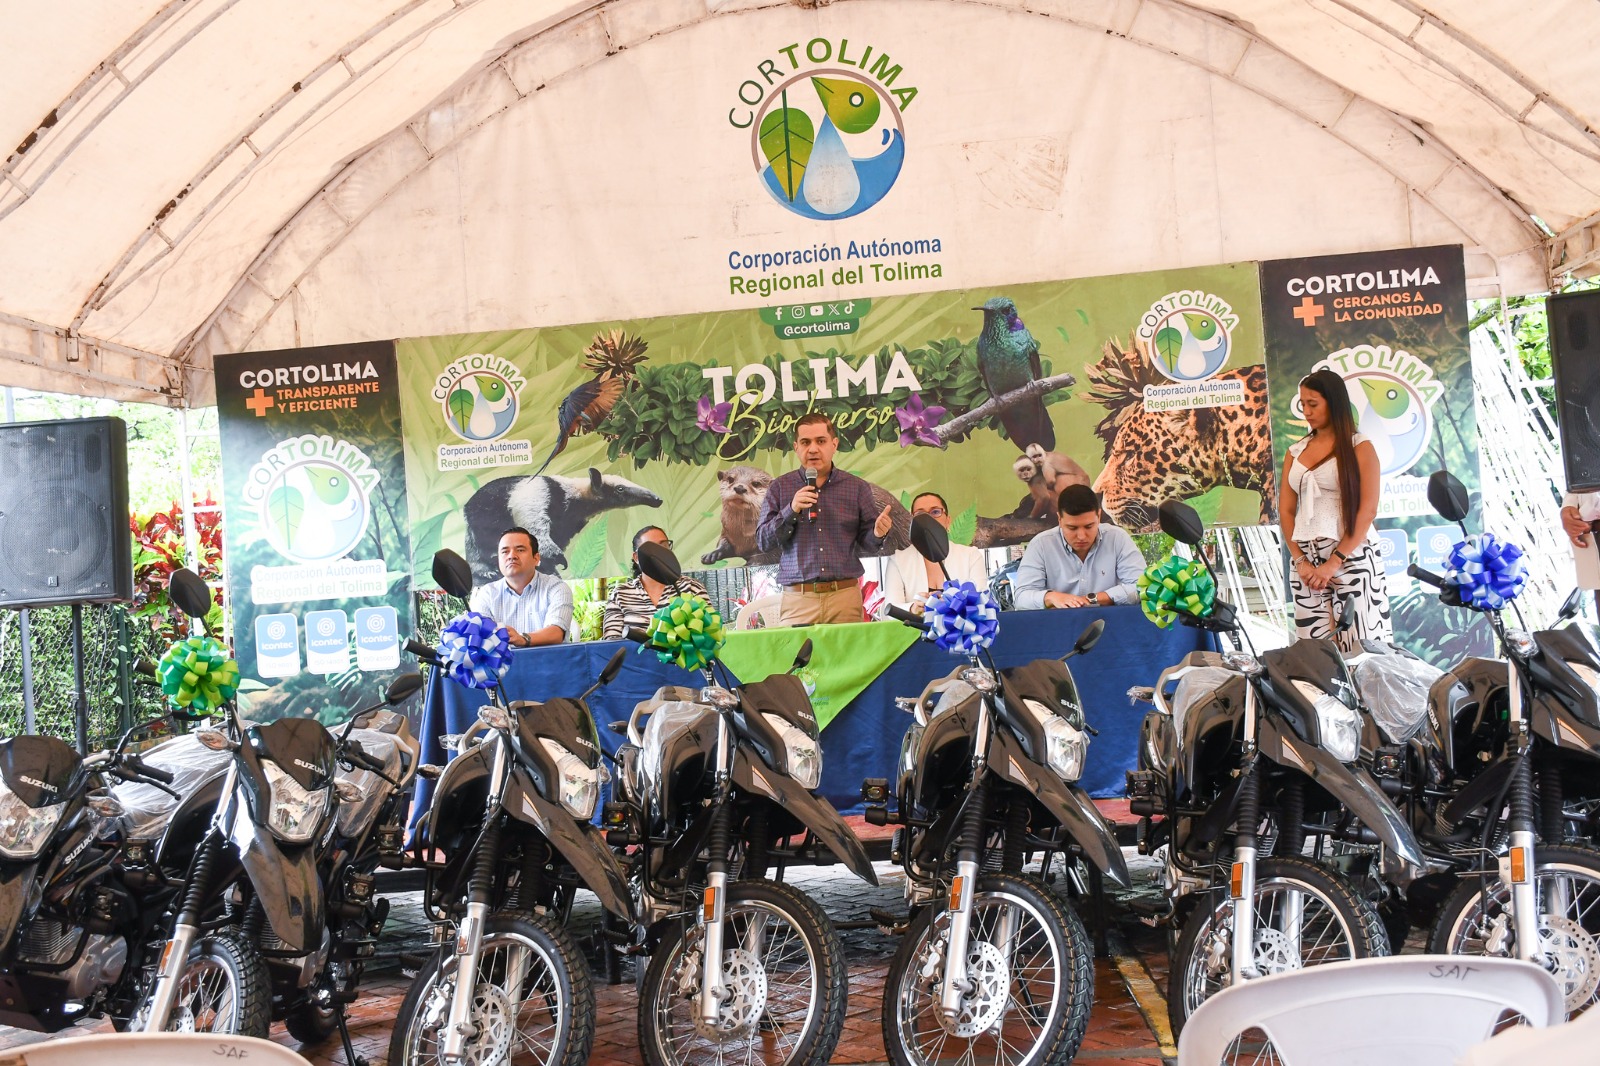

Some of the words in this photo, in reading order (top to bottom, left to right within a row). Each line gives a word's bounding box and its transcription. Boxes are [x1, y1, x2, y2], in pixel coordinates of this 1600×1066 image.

[729, 38, 918, 128] CORTOLIMA
[729, 243, 841, 271] Corporación
[847, 238, 942, 259] Autónoma
[729, 269, 824, 297] Regional
[832, 265, 863, 285] del
[870, 262, 942, 282] Tolima
[1287, 266, 1441, 296] CORTOLIMA
[1333, 293, 1411, 308] CERCANOS
[1414, 291, 1424, 302] A
[1140, 294, 1235, 338] CORTOLIMA
[1334, 312, 1352, 323] LA
[1354, 303, 1443, 320] COMUNIDAD
[784, 321, 850, 336] @cortolima
[240, 360, 379, 388] CORTOLIMA
[434, 357, 523, 400] CORTOLIMA
[702, 351, 922, 407] TOLIMA
[276, 382, 380, 400] TRANSPARENTE
[1146, 385, 1197, 397] Corporación
[1198, 382, 1241, 394] Autónoma
[277, 402, 287, 413] Y
[289, 397, 358, 413] EFICIENTE
[1147, 397, 1190, 410] Regional
[1192, 394, 1207, 405] del
[1209, 392, 1241, 403] Tolima
[440, 444, 488, 457] Corporación
[489, 441, 528, 453] Autónoma
[248, 438, 378, 501] CORTOLIMA
[441, 456, 481, 469] Regional
[483, 452, 497, 465] del
[499, 450, 529, 462] Tolima
[1384, 480, 1427, 494] Autóno
[256, 584, 313, 601] Regional
[317, 582, 337, 595] del
[340, 579, 383, 593] Tolima
[293, 758, 327, 776] SUZUKI
[20, 775, 58, 793] SUZUKI
[64, 832, 94, 864] SUZUKI
